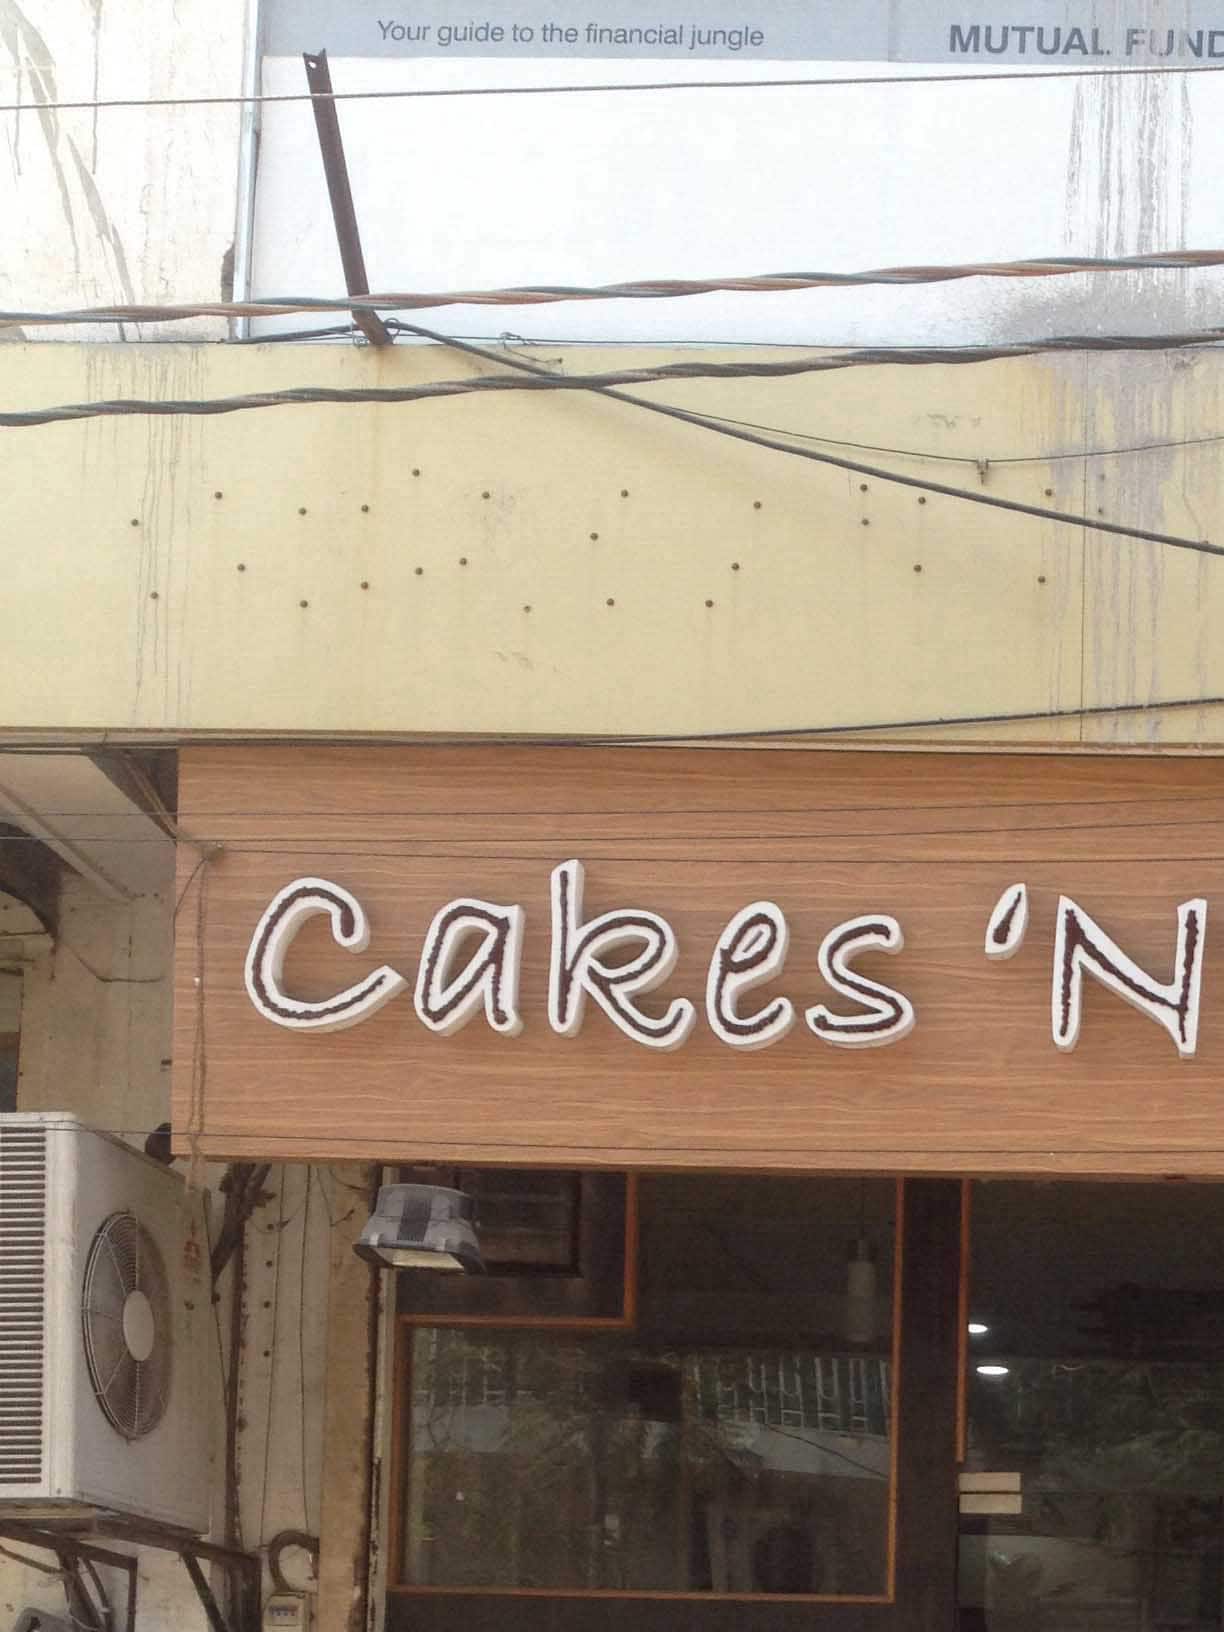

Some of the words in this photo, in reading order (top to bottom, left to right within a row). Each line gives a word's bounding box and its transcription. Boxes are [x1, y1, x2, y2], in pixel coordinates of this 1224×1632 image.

[378, 20, 431, 41] Your
[437, 21, 504, 46] guide
[512, 24, 534, 43] to
[541, 23, 578, 44] the
[585, 24, 683, 46] financial
[688, 26, 764, 51] jungle
[949, 24, 1107, 56] MUTUAL
[244, 858, 918, 1052] Cakes
